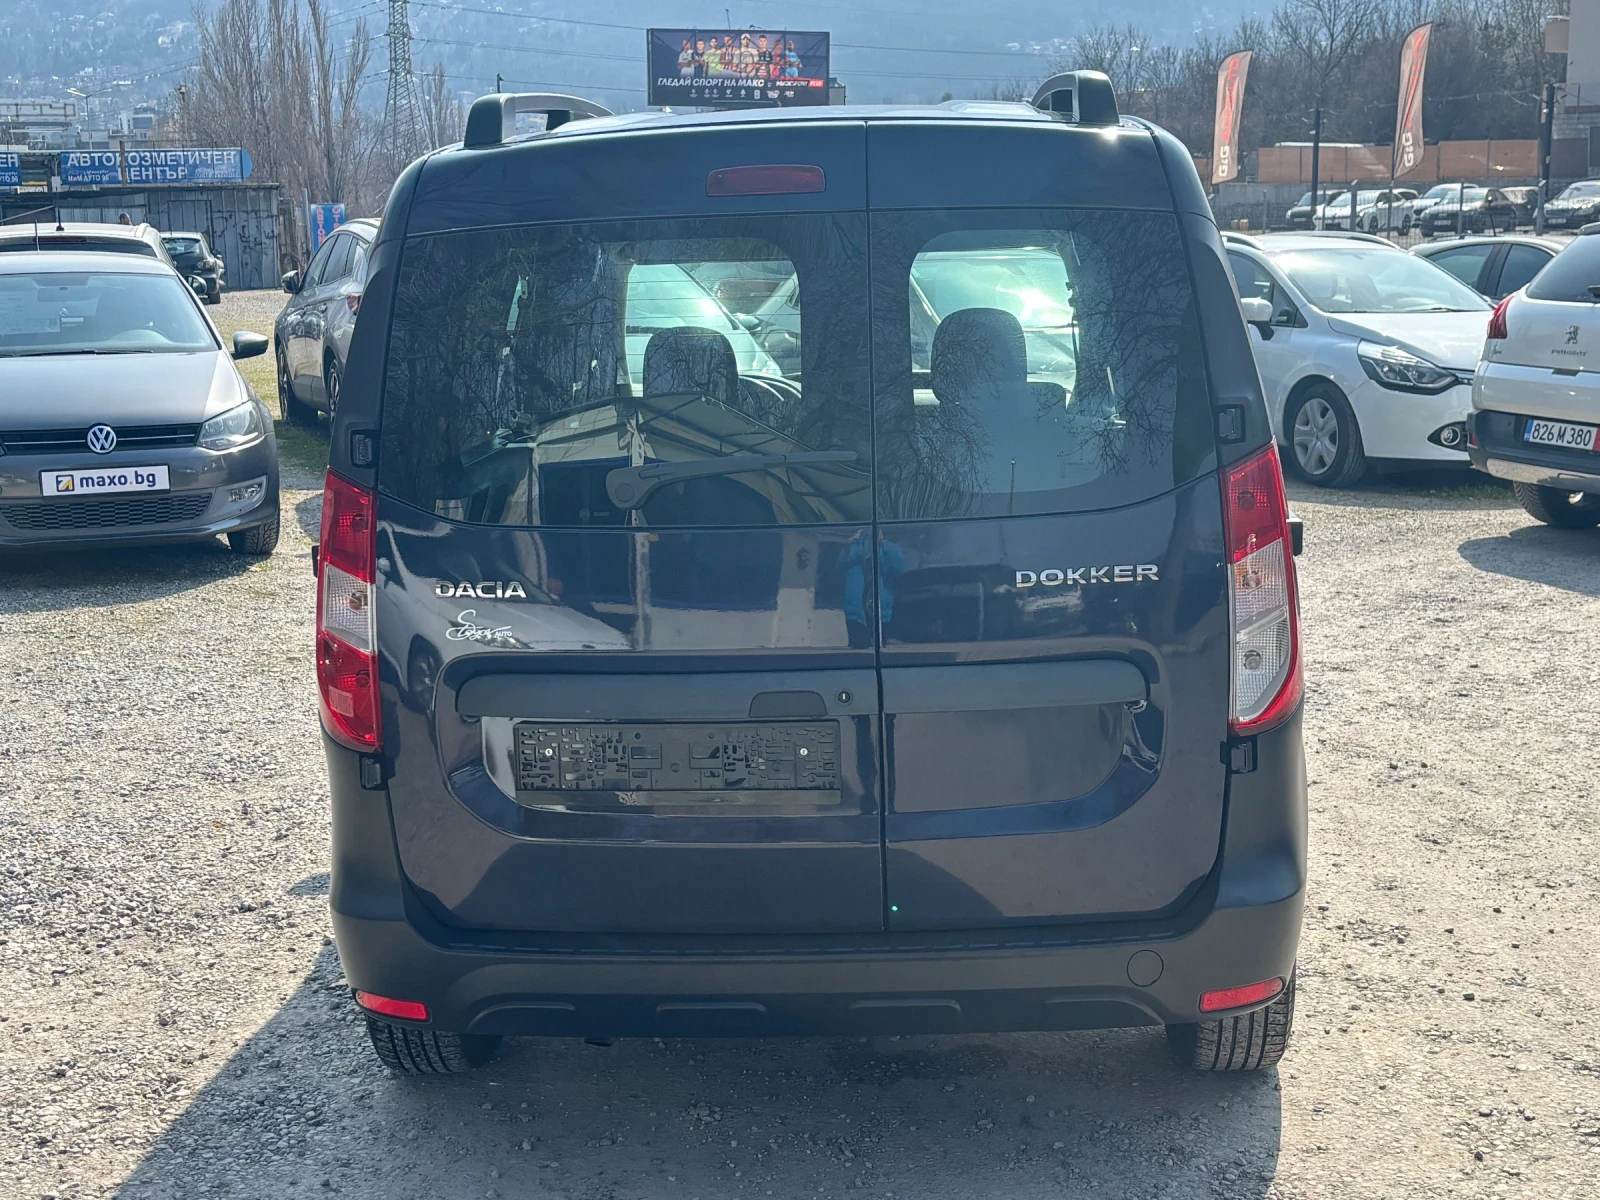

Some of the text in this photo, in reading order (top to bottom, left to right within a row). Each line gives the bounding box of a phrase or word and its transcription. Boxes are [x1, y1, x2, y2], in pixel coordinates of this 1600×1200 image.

[657, 77, 692, 87] ГЛЕДАЙ
[692, 78, 723, 87] СПОРТ
[723, 79, 737, 87] НА
[737, 79, 765, 87] МАКС
[1532, 423, 1554, 442] 826
[1566, 428, 1592, 446] 380
[79, 471, 156, 489] maxo.bg
[1015, 564, 1159, 588] DOKKER
[435, 580, 527, 599] DACIA
